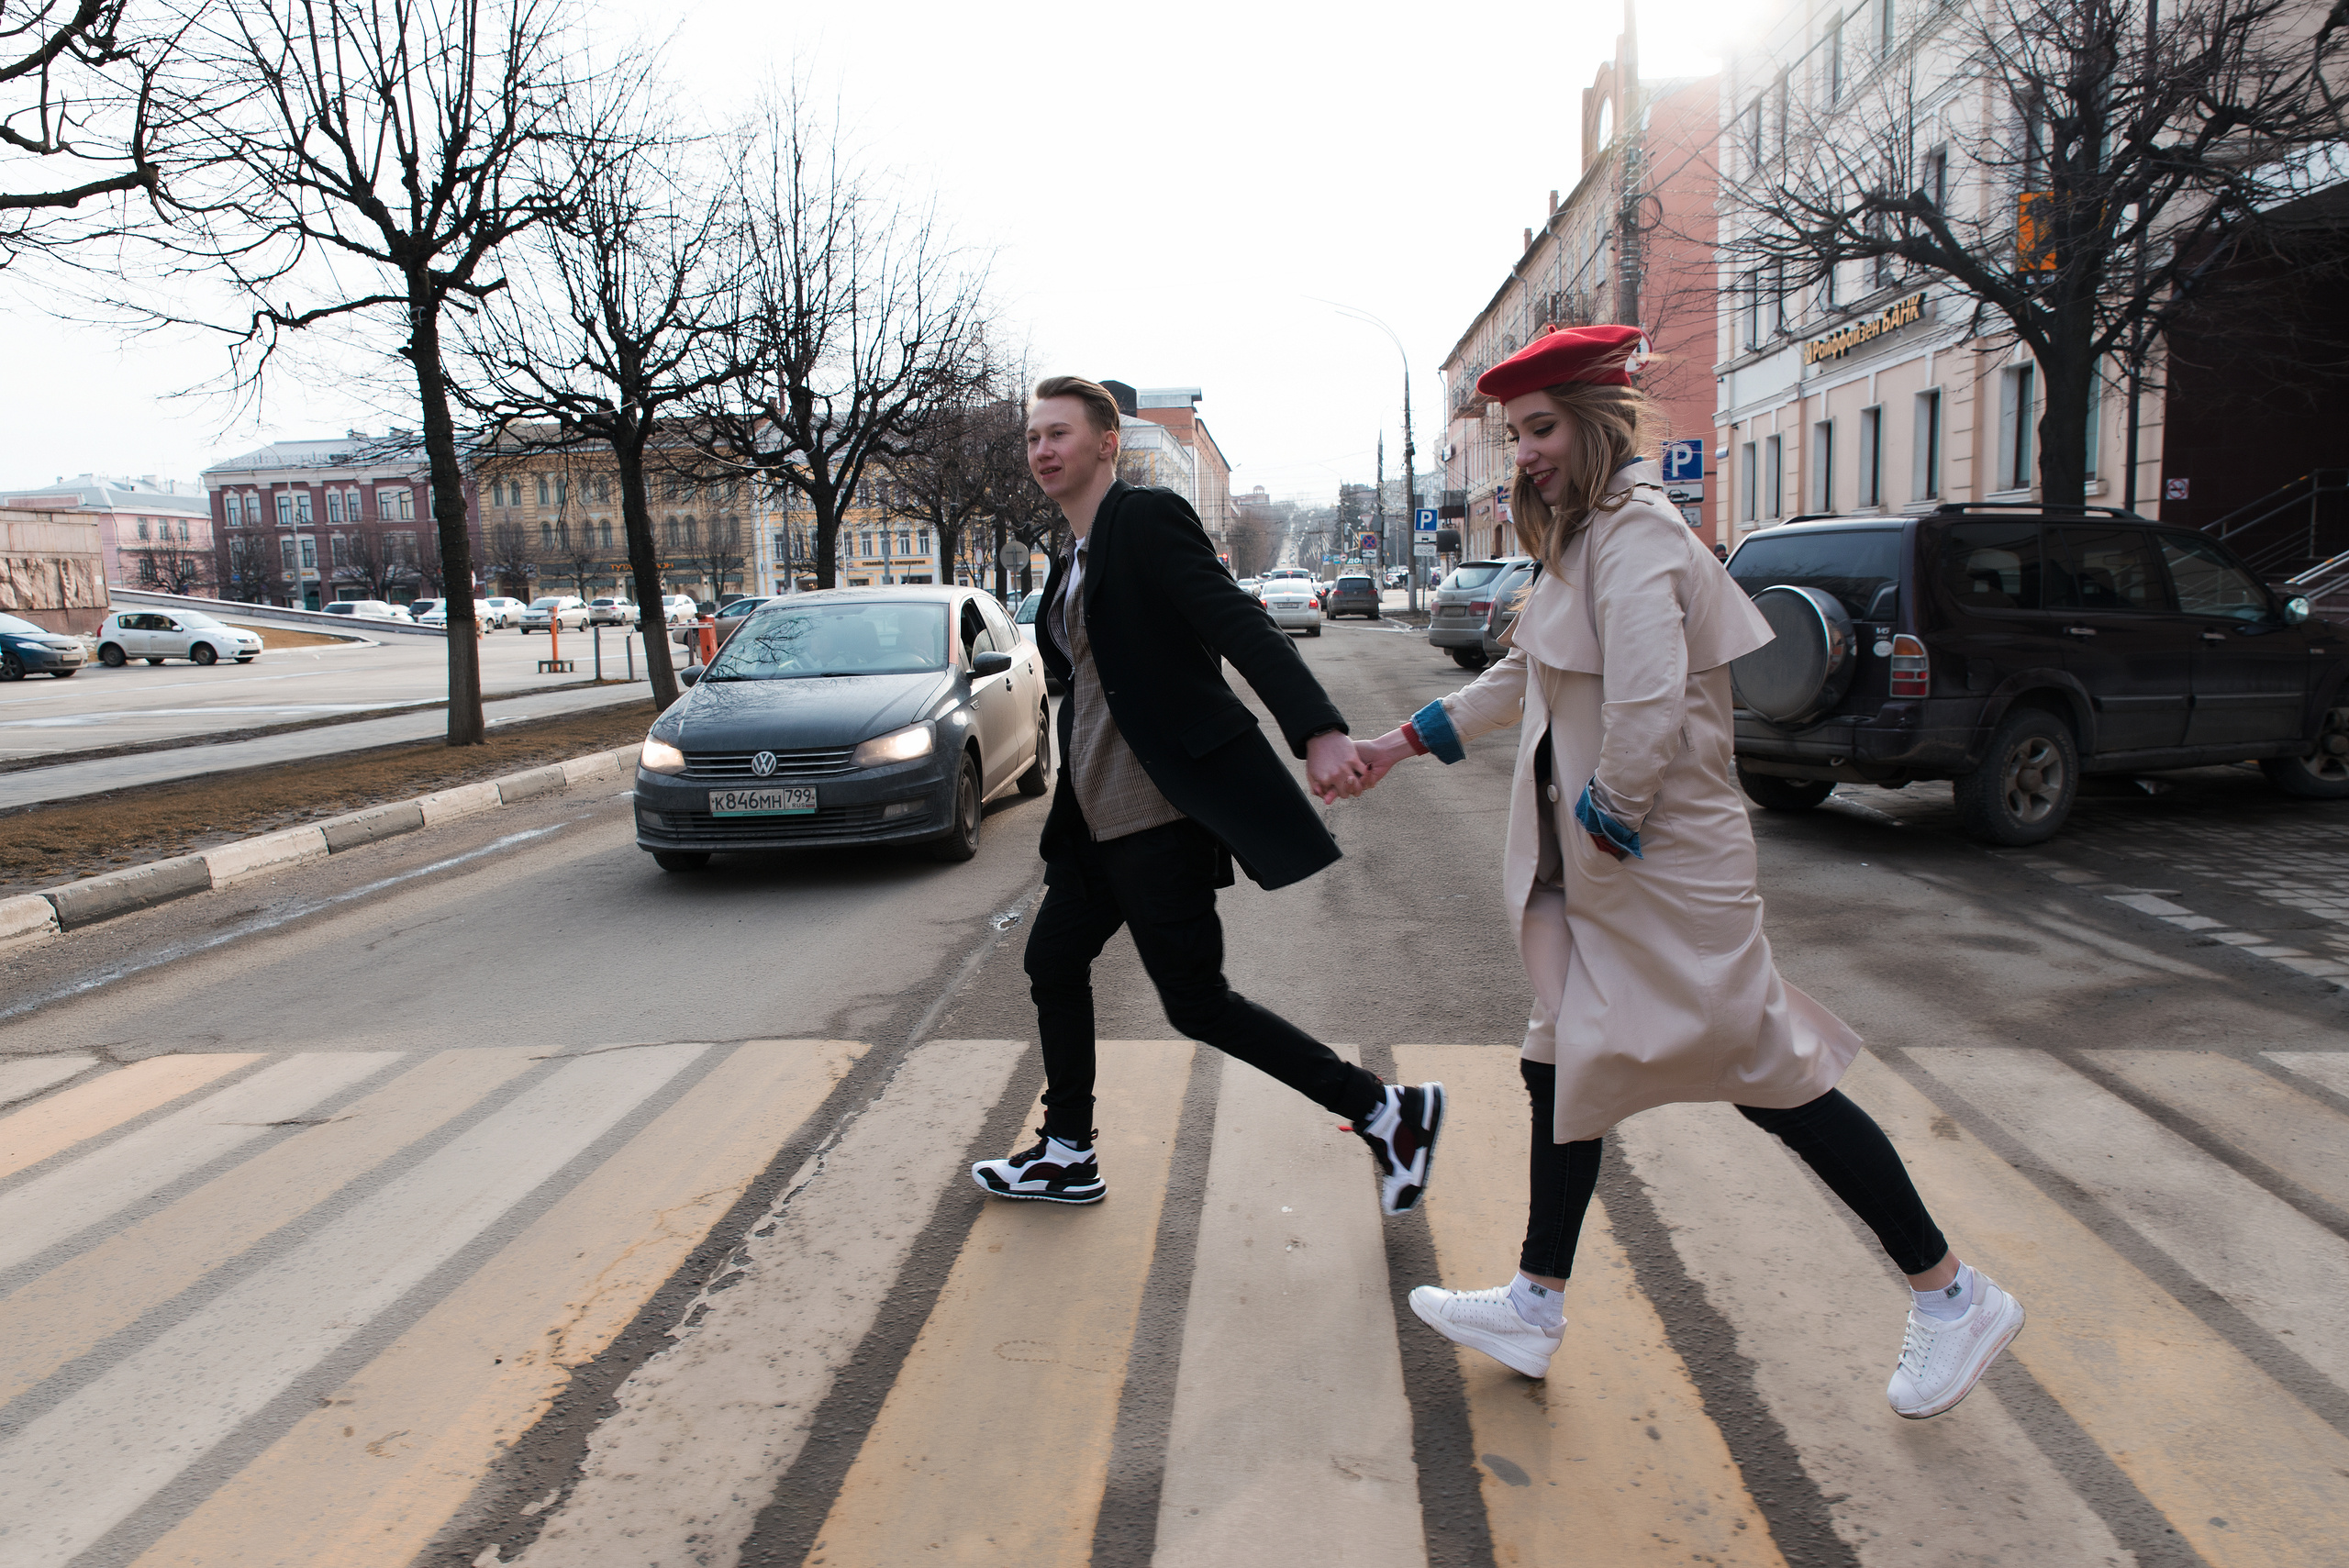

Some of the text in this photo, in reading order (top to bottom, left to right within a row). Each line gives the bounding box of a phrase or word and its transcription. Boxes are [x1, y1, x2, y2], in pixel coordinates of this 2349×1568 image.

[1882, 293, 1923, 333] БАНК
[1671, 443, 1693, 478] P
[1419, 510, 1433, 529] P
[785, 789, 811, 803] 799
